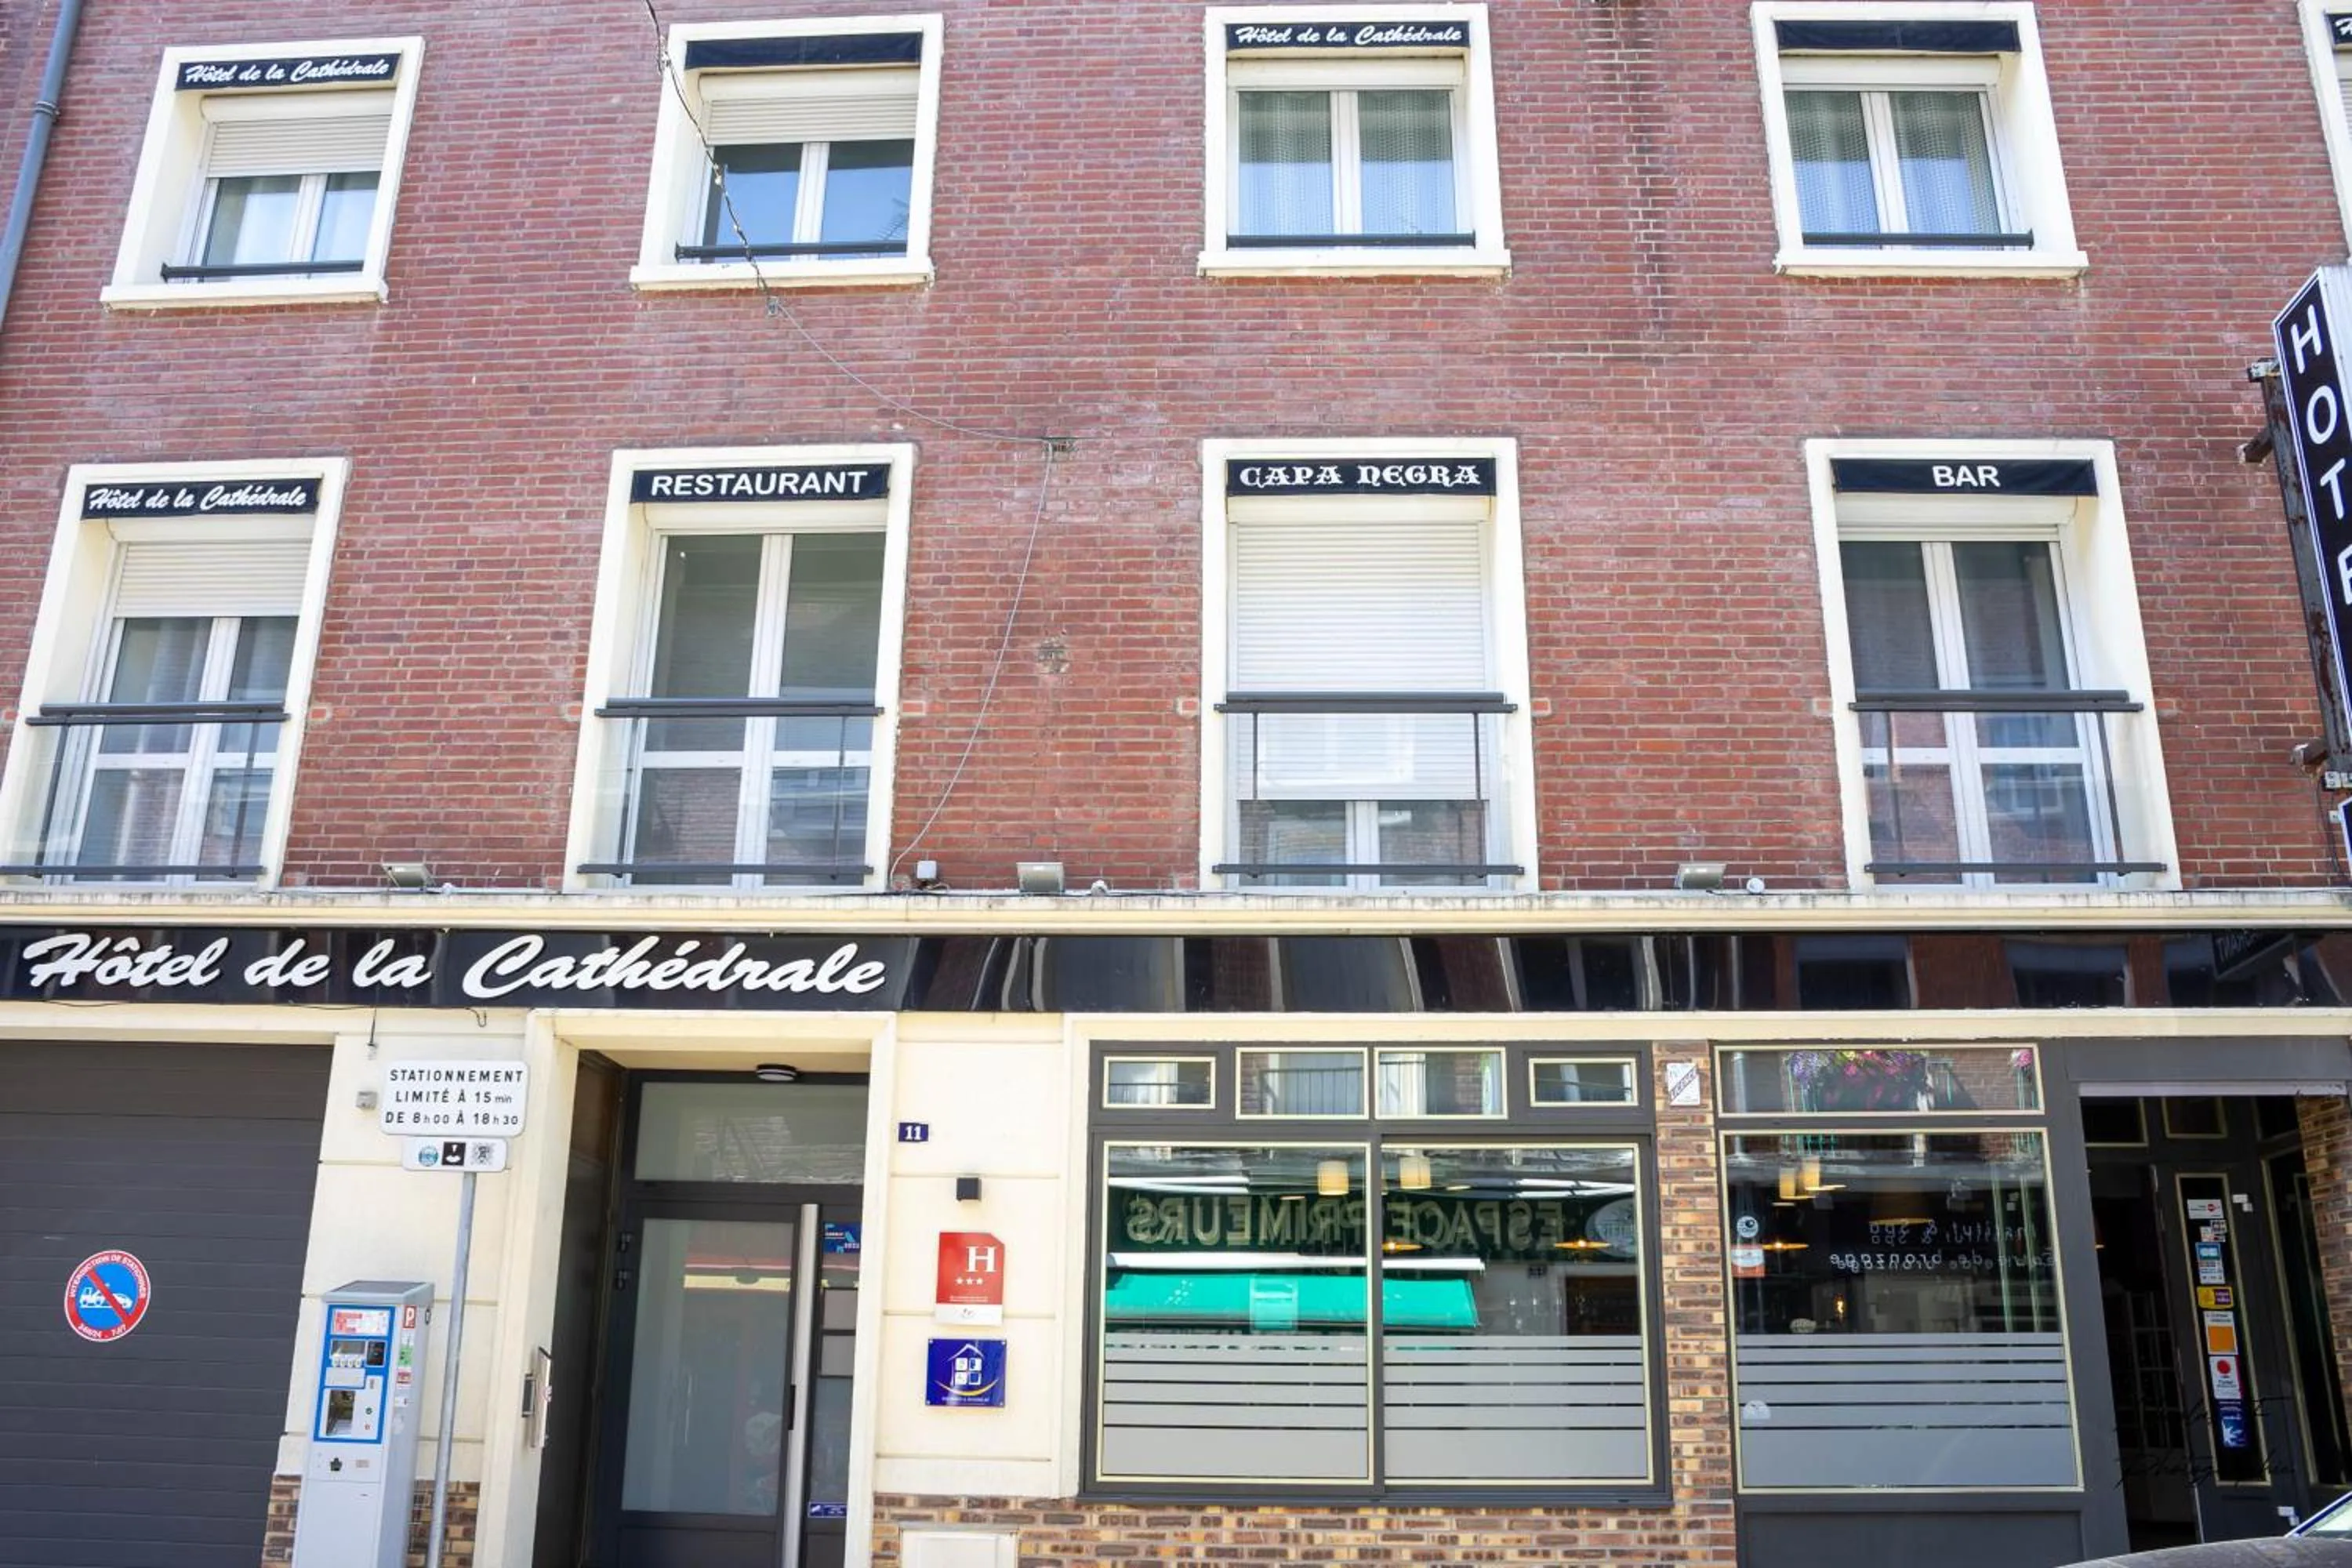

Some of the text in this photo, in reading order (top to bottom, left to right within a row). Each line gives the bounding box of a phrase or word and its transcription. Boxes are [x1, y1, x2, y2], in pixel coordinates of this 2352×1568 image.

[1235, 24, 1461, 45] Hôtel de la Cathédrale
[185, 59, 389, 82] Hôtel de la Cathédrale
[651, 471, 867, 495] RESTAURANT
[1240, 465, 1481, 488] CAPA NEGRA
[1932, 465, 2001, 487] BAR
[89, 485, 307, 510] Hôtel de la Cathédrale
[23, 934, 885, 999] Hôtel de la Cathédrale
[390, 1069, 523, 1083] STATIONNEMENT
[395, 1088, 450, 1103] LIMITÉ
[457, 1088, 466, 1103] À
[385, 1112, 405, 1123] DE
[456, 1109, 464, 1124] À
[906, 1125, 921, 1140] 11
[966, 1247, 996, 1272] H
